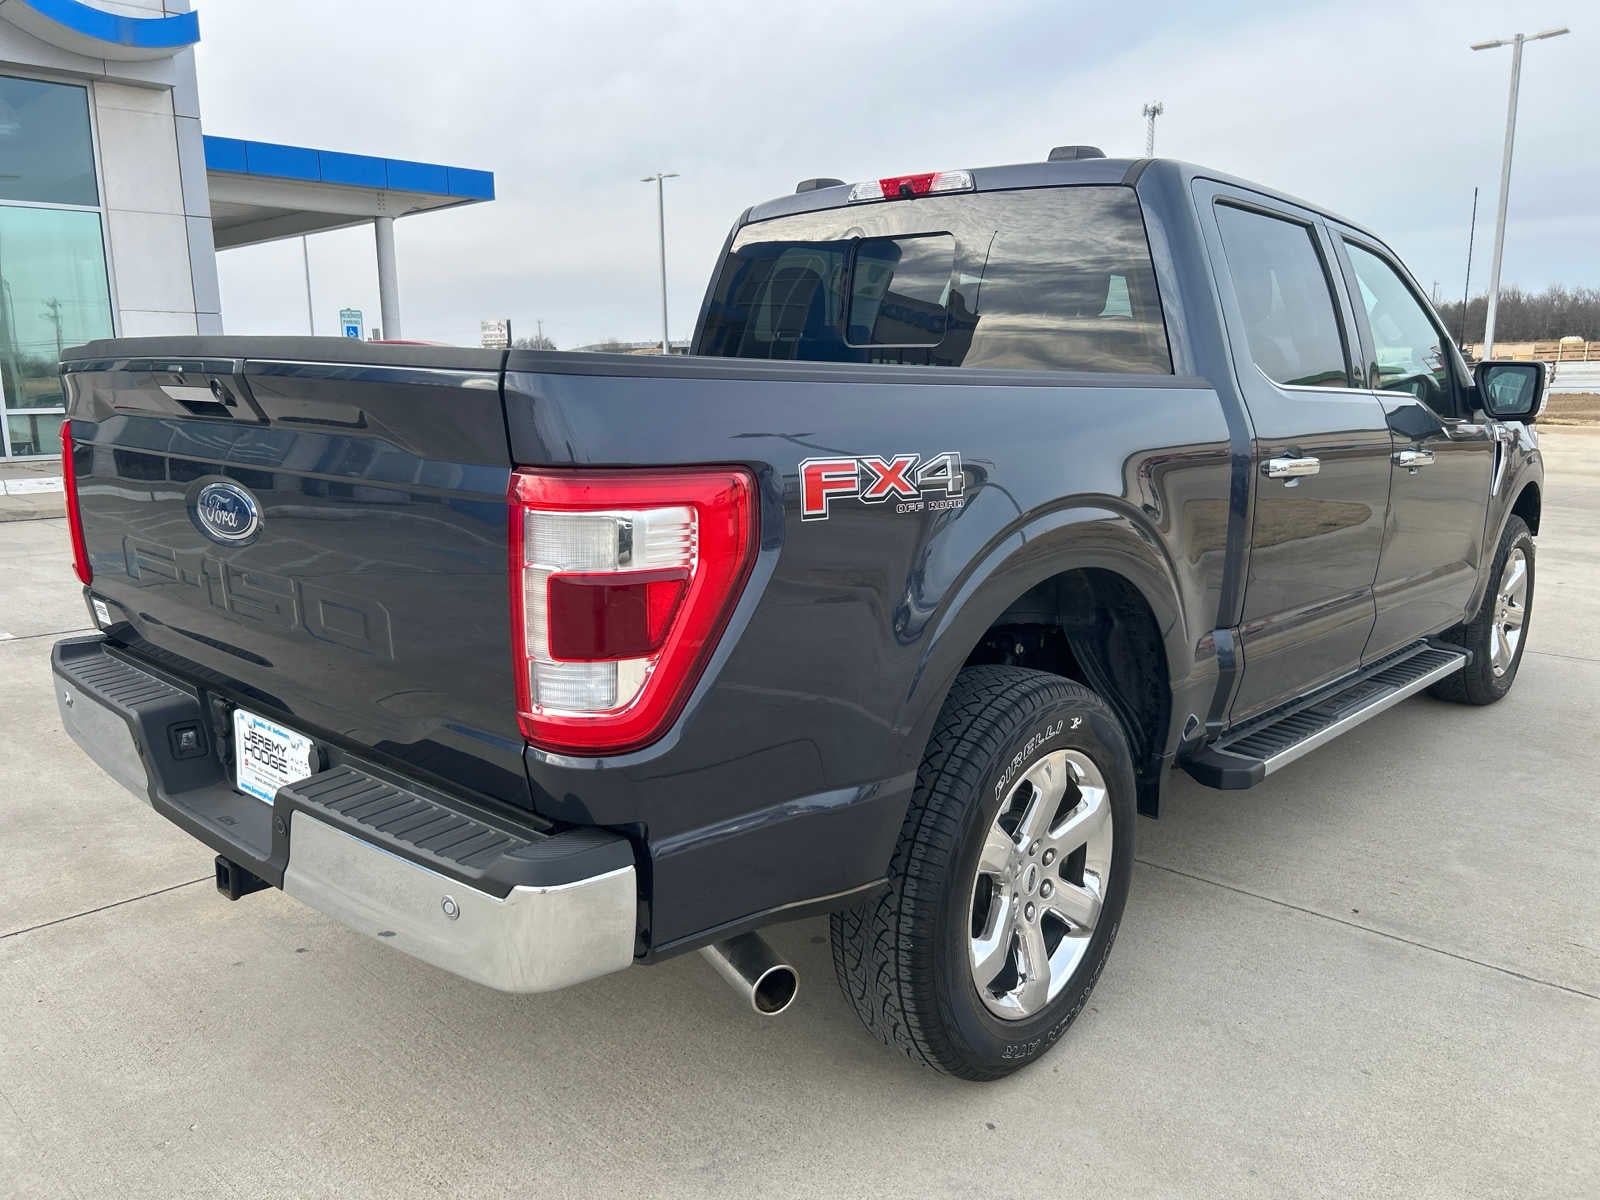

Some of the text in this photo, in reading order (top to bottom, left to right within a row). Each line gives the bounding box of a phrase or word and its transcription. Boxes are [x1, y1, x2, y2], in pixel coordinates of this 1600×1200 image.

[798, 452, 965, 521] FX4
[207, 494, 239, 528] Ford
[896, 499, 964, 513] OFF ROAD
[243, 730, 287, 757] JEREMY
[243, 740, 288, 775] HODGE
[995, 720, 1063, 801] PIRELLI
